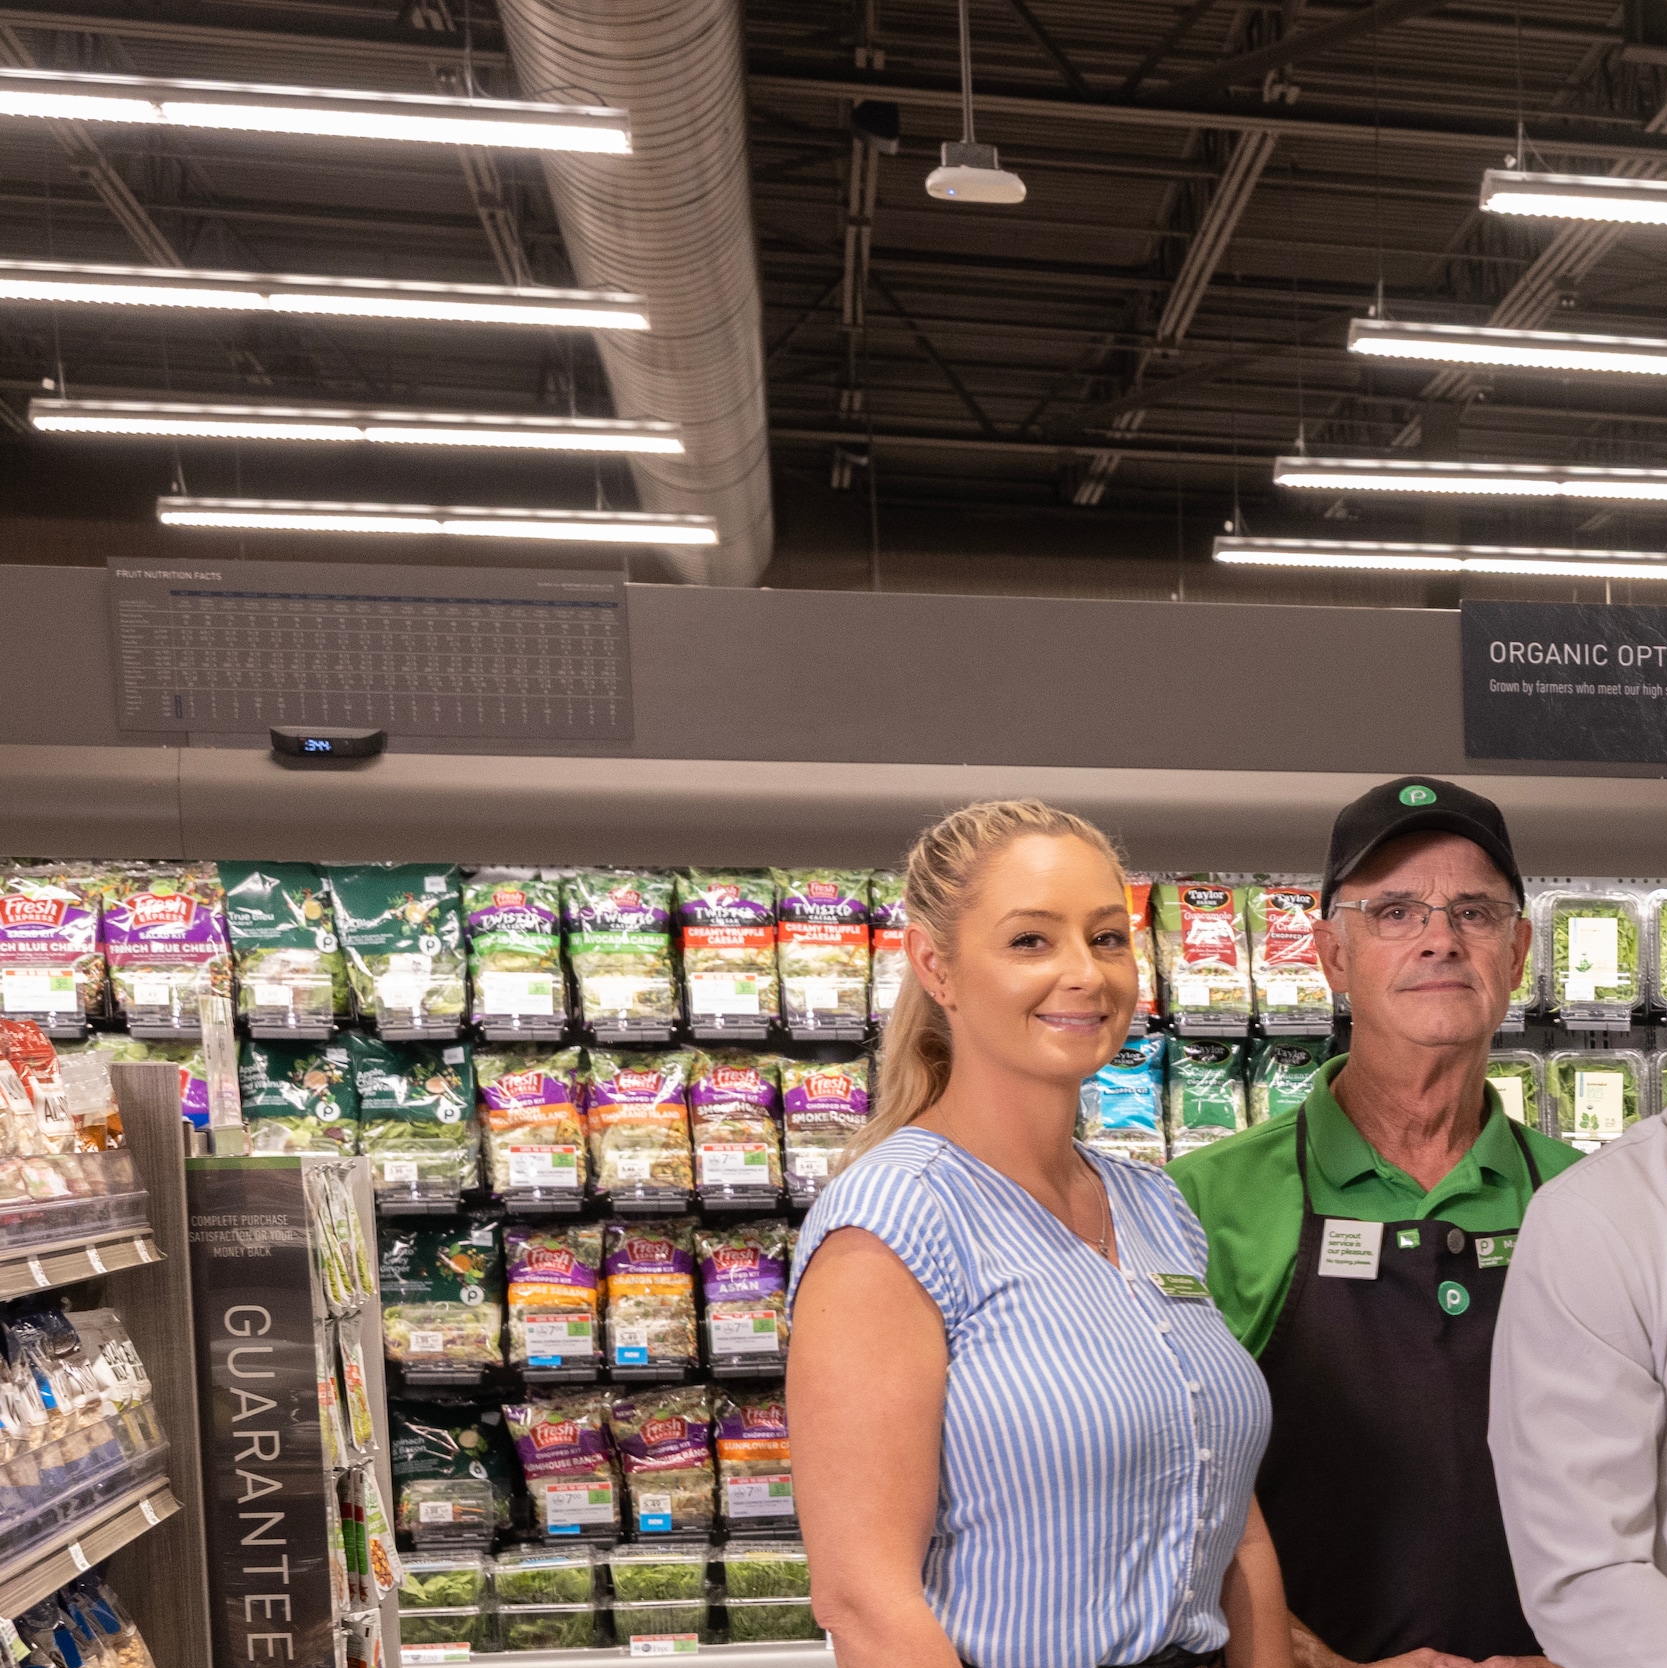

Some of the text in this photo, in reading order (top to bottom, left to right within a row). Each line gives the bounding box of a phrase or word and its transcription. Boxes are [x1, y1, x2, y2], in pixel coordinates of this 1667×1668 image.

[116, 569, 222, 581] FRUIT NUTRITION FACTS
[1490, 641, 1608, 666] ORGANIC
[1490, 679, 1519, 693] Grown
[1522, 680, 1533, 695] by
[1536, 680, 1573, 694] farmers
[1576, 682, 1595, 695] who
[1598, 684, 1622, 695] meet
[1624, 686, 1640, 695] our
[1642, 684, 1662, 698] high
[1189, 889, 1224, 900] Taylor
[5, 898, 58, 914] Fresh
[229, 911, 250, 921] True
[785, 922, 822, 933] CREAMY
[810, 1073, 847, 1090] Fresh
[191, 1213, 289, 1227] COMPLETE PURCHASE
[189, 1229, 295, 1244] SATISFACTION OR YOUR
[1329, 1231, 1361, 1241] Carryout
[213, 1244, 272, 1259] MONEY BACK
[631, 1239, 670, 1253] Fresh
[1328, 1240, 1352, 1248] service
[531, 1248, 569, 1264] Fresh
[715, 1246, 754, 1262] Fresh
[744, 1407, 783, 1422] Fresh
[535, 1423, 575, 1440] Fresh
[643, 1417, 682, 1435] Fresh
[724, 1441, 777, 1451] SUNFLOWER
